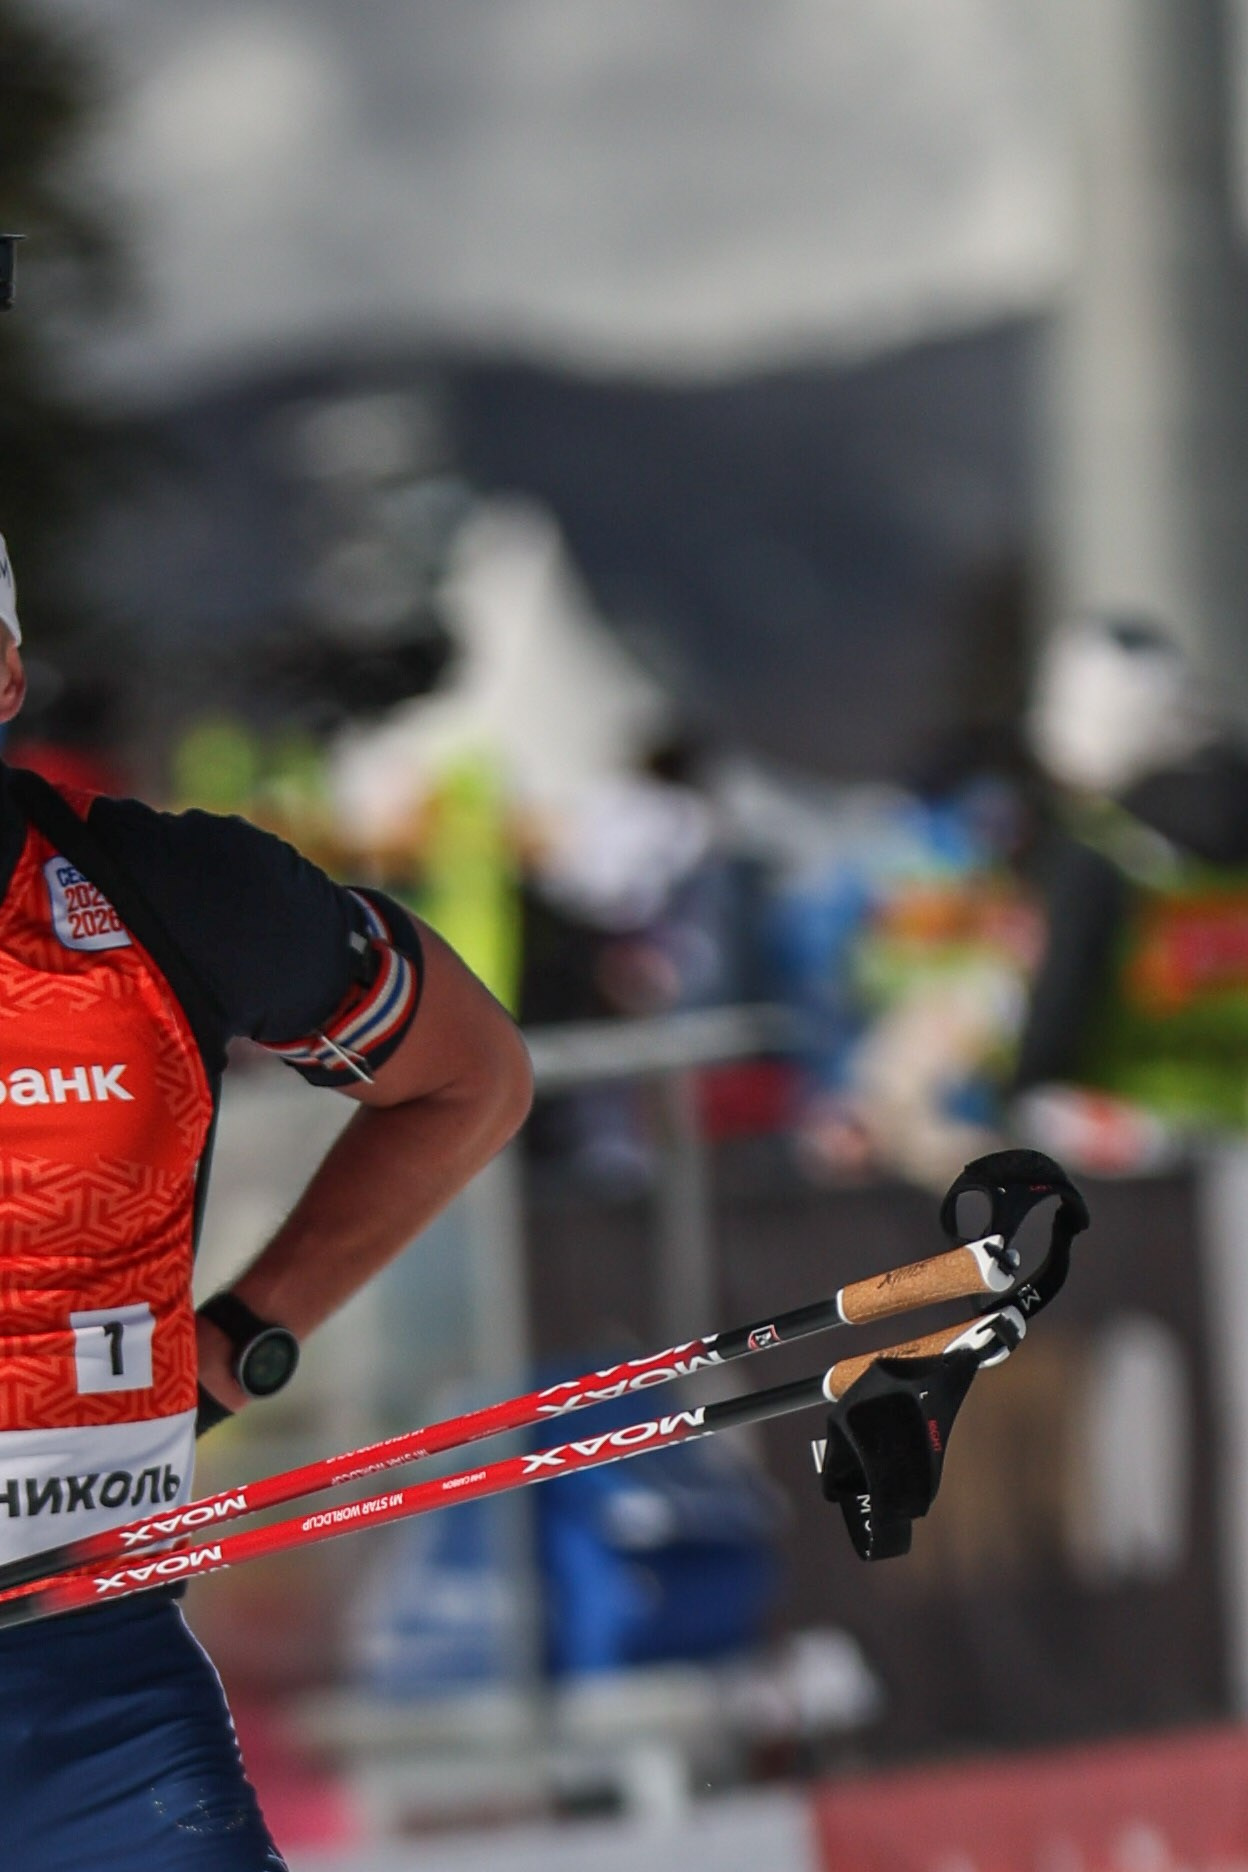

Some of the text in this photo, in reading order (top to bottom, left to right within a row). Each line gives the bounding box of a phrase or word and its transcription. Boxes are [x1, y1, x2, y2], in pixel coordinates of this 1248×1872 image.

[67, 908, 124, 939] 2026
[102, 1320, 125, 1376] 1
[536, 1350, 727, 1415] MOAX
[521, 1406, 706, 1474] MOAX
[119, 1494, 248, 1547] MOAX
[302, 1503, 361, 1532] WORLDCUP
[362, 1496, 388, 1515] STAR
[93, 1545, 223, 1594] MOAX
